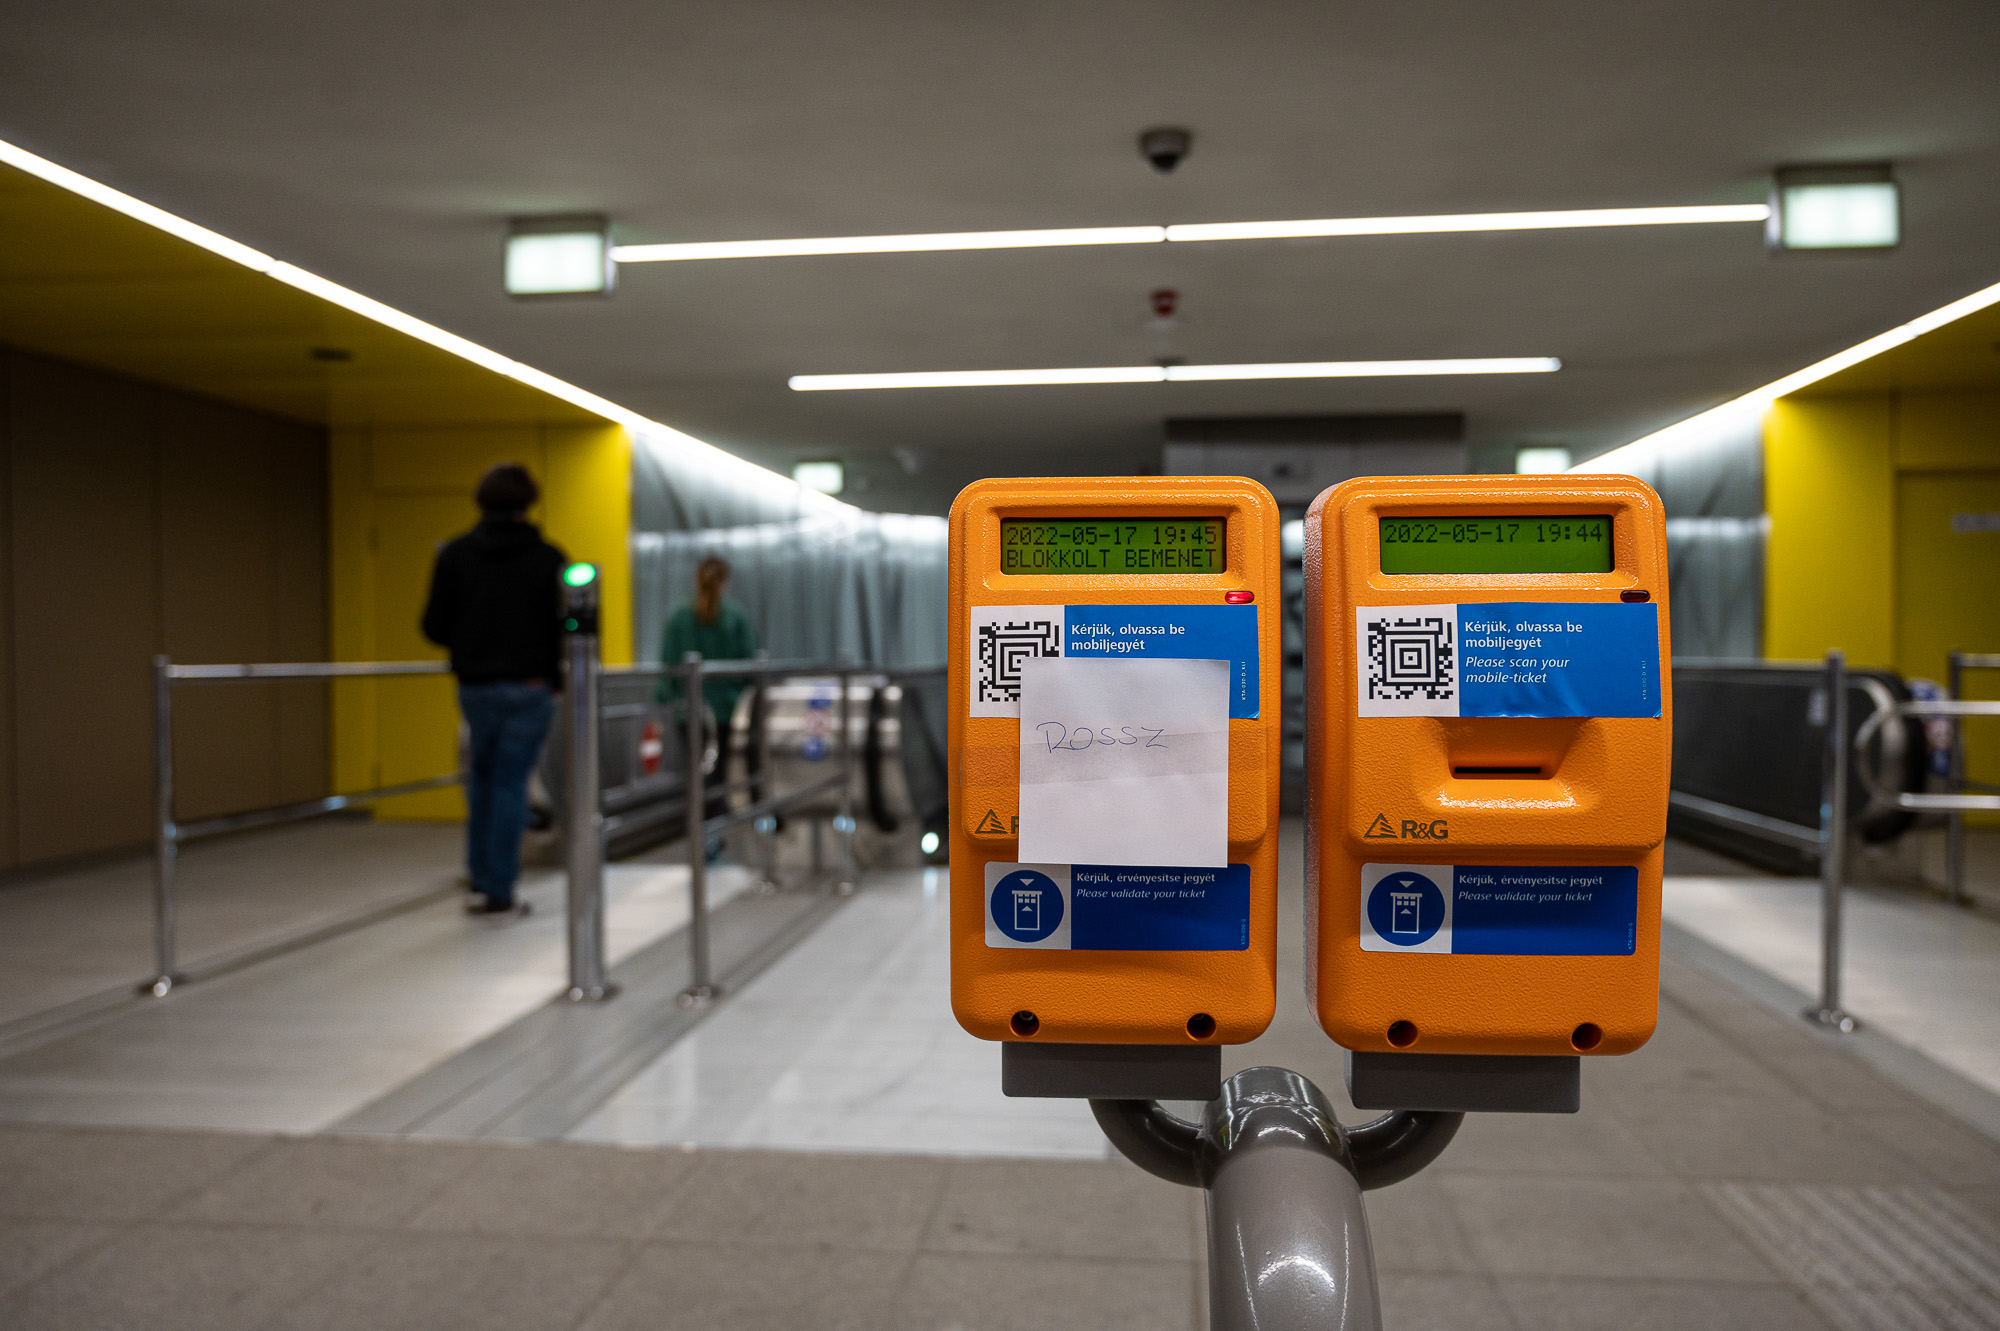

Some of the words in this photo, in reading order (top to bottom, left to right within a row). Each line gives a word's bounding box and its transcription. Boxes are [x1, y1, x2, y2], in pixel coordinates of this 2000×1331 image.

[1007, 527, 1136, 545] 2022-05-17
[1154, 527, 1217, 544] 19:45
[1386, 524, 1520, 543] 2022-05-17
[1537, 524, 1603, 542] 19:44
[1007, 549, 1110, 568] BLOKKOLT
[1126, 549, 1216, 568] BEMENET
[1072, 624, 1115, 636] Kérjük,
[1120, 624, 1166, 635] olvassa
[1170, 624, 1185, 635] be
[1465, 621, 1511, 634] Kérjük,
[1516, 621, 1562, 632] olvassa
[1567, 621, 1582, 632] be
[1072, 638, 1145, 652] mobiljegyét
[1465, 637, 1541, 650] mobiljegyét
[1466, 656, 1505, 668] Please
[1510, 659, 1537, 668] scan
[1541, 659, 1569, 670] your
[1466, 672, 1547, 683] mobile-ticket
[1036, 722, 1168, 753] ROSSZ
[1402, 820, 1448, 839] R&G
[1077, 873, 1113, 883] Kérjük,
[1183, 873, 1215, 885] jegyét
[1459, 875, 1497, 886] Kérjük,
[1570, 876, 1603, 887] jegyét
[1076, 889, 1108, 898] Please
[1111, 889, 1151, 898] validate
[1153, 891, 1177, 900] your
[1179, 889, 1206, 898] ticket
[1459, 891, 1492, 901] Please
[1494, 892, 1536, 901] validate
[1538, 894, 1562, 904] your
[1565, 892, 1592, 901] ticket
